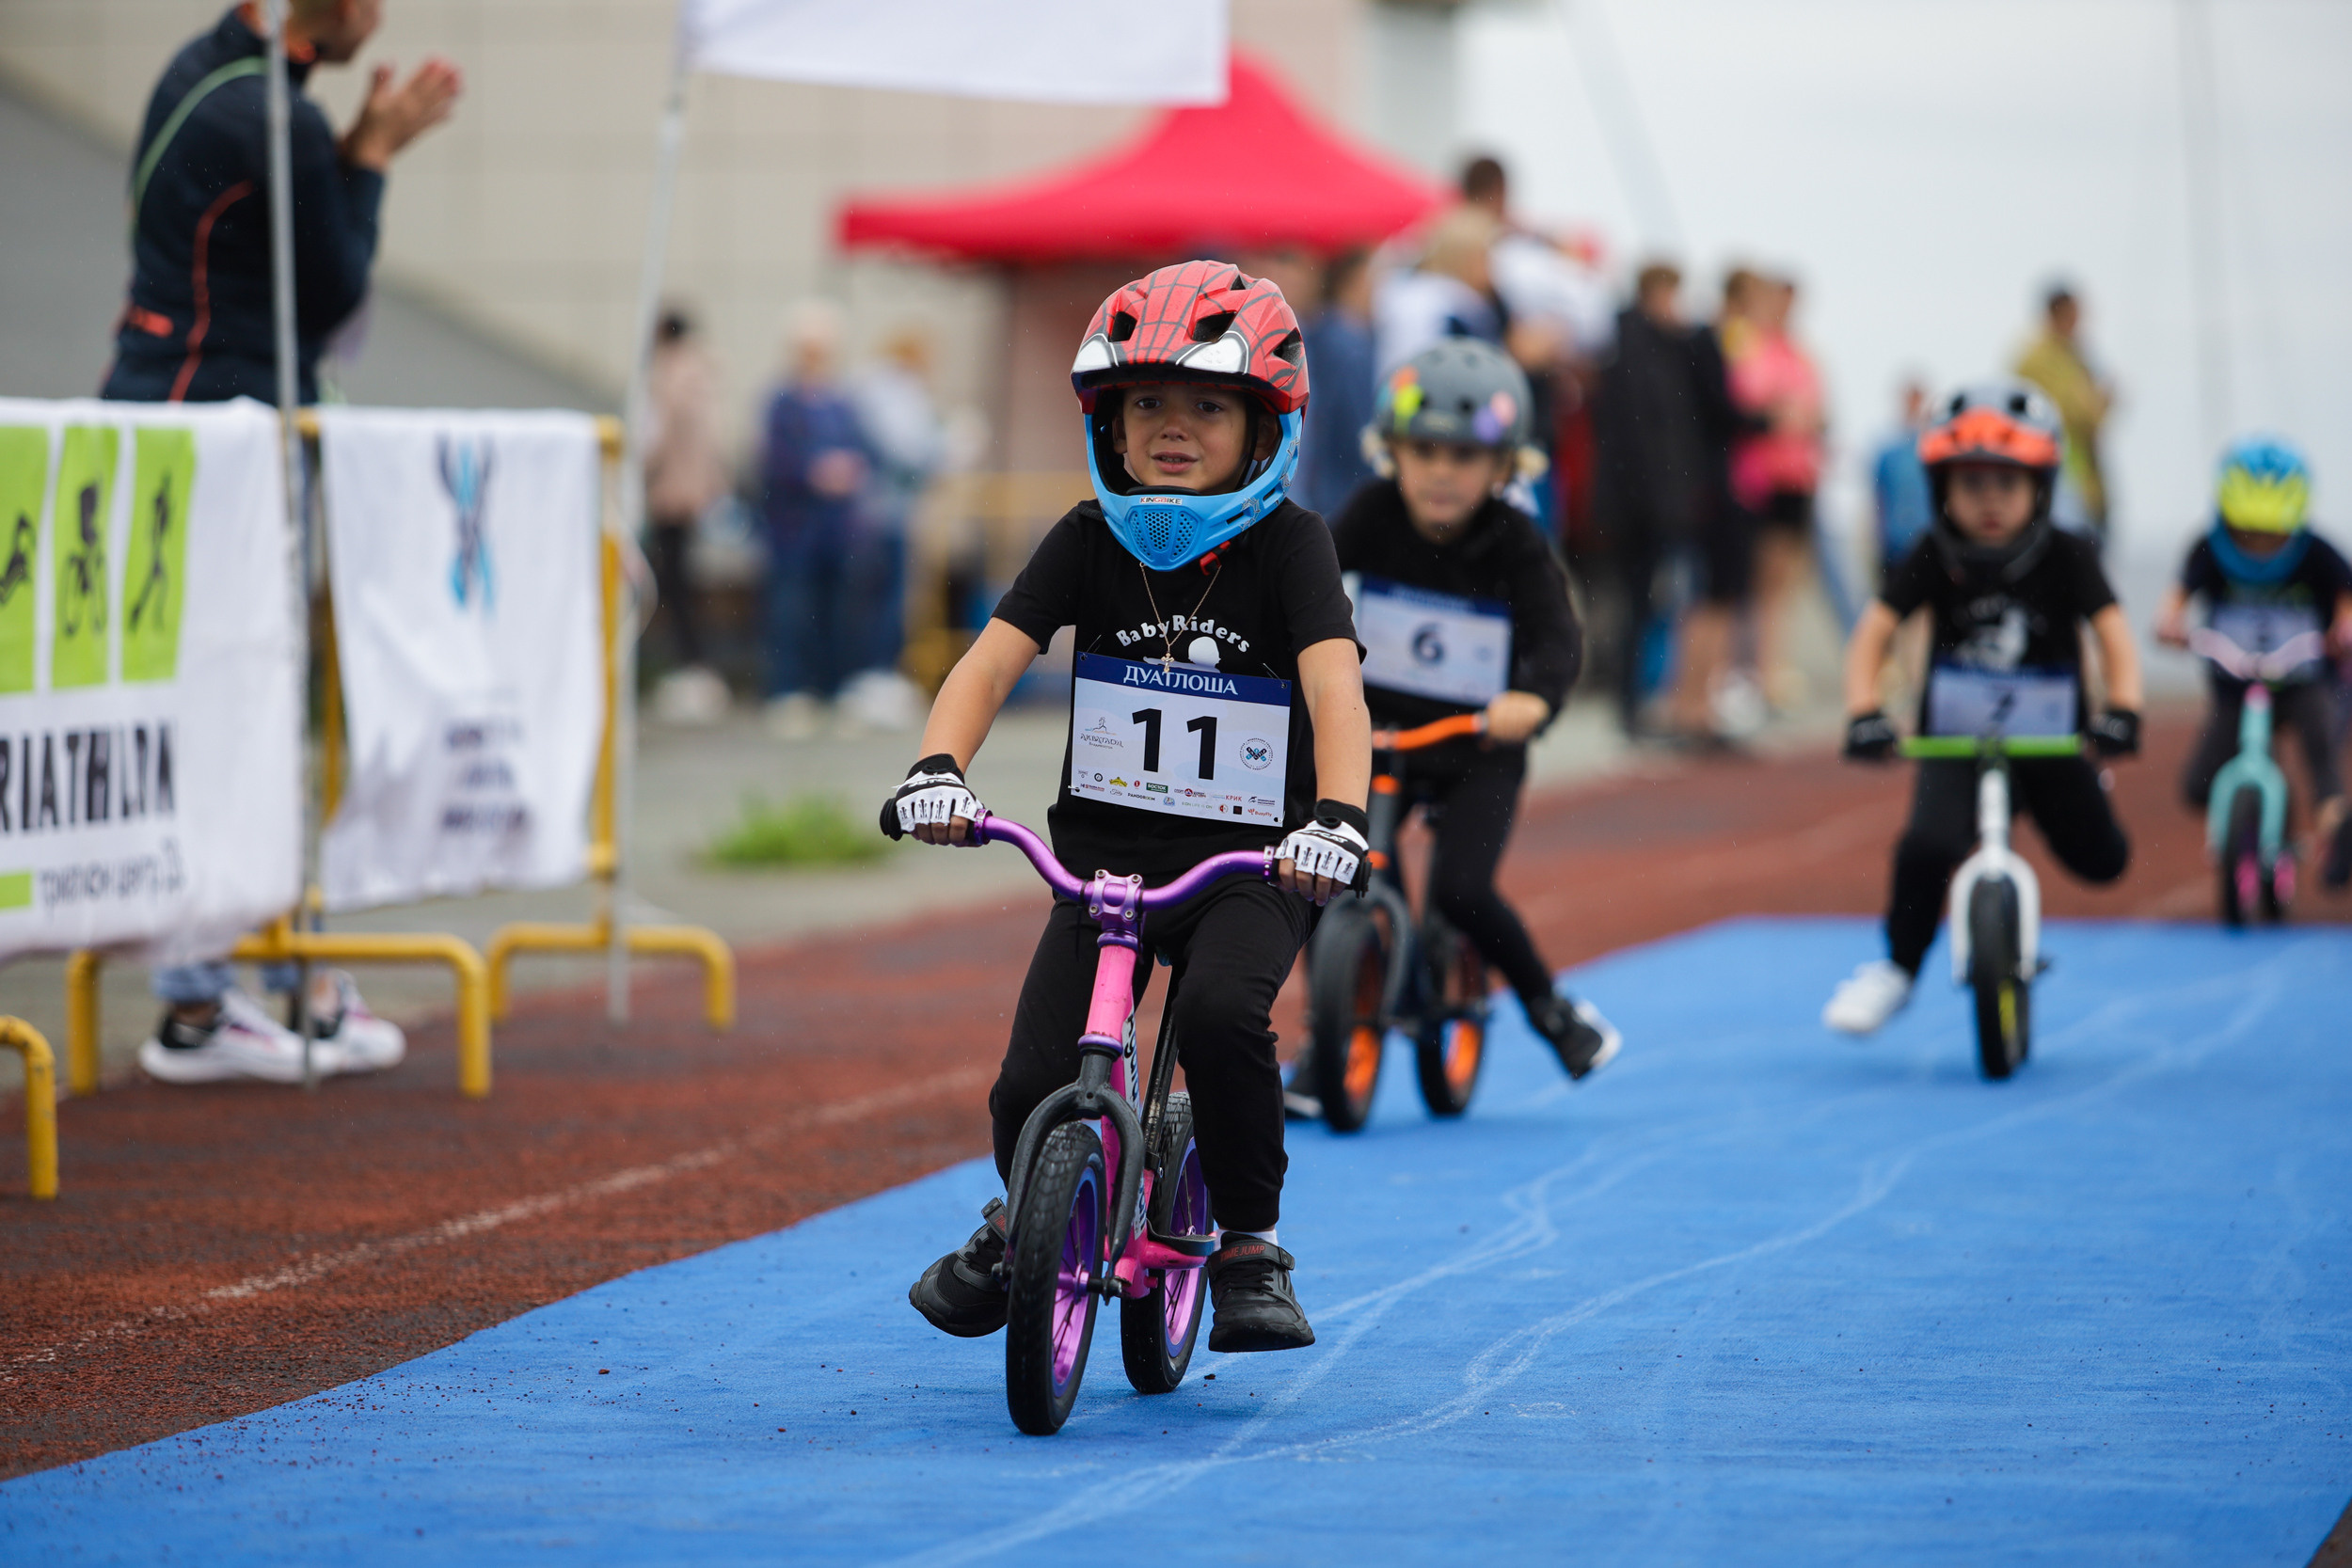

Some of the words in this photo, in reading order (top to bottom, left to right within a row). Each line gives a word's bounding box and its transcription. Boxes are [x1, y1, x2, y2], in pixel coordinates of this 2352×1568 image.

[1139, 497, 1182, 505] KINGBIKE
[1411, 622, 1445, 667] 6
[1122, 665, 1239, 696] ДУАТЛОША
[1132, 708, 1217, 781] 11
